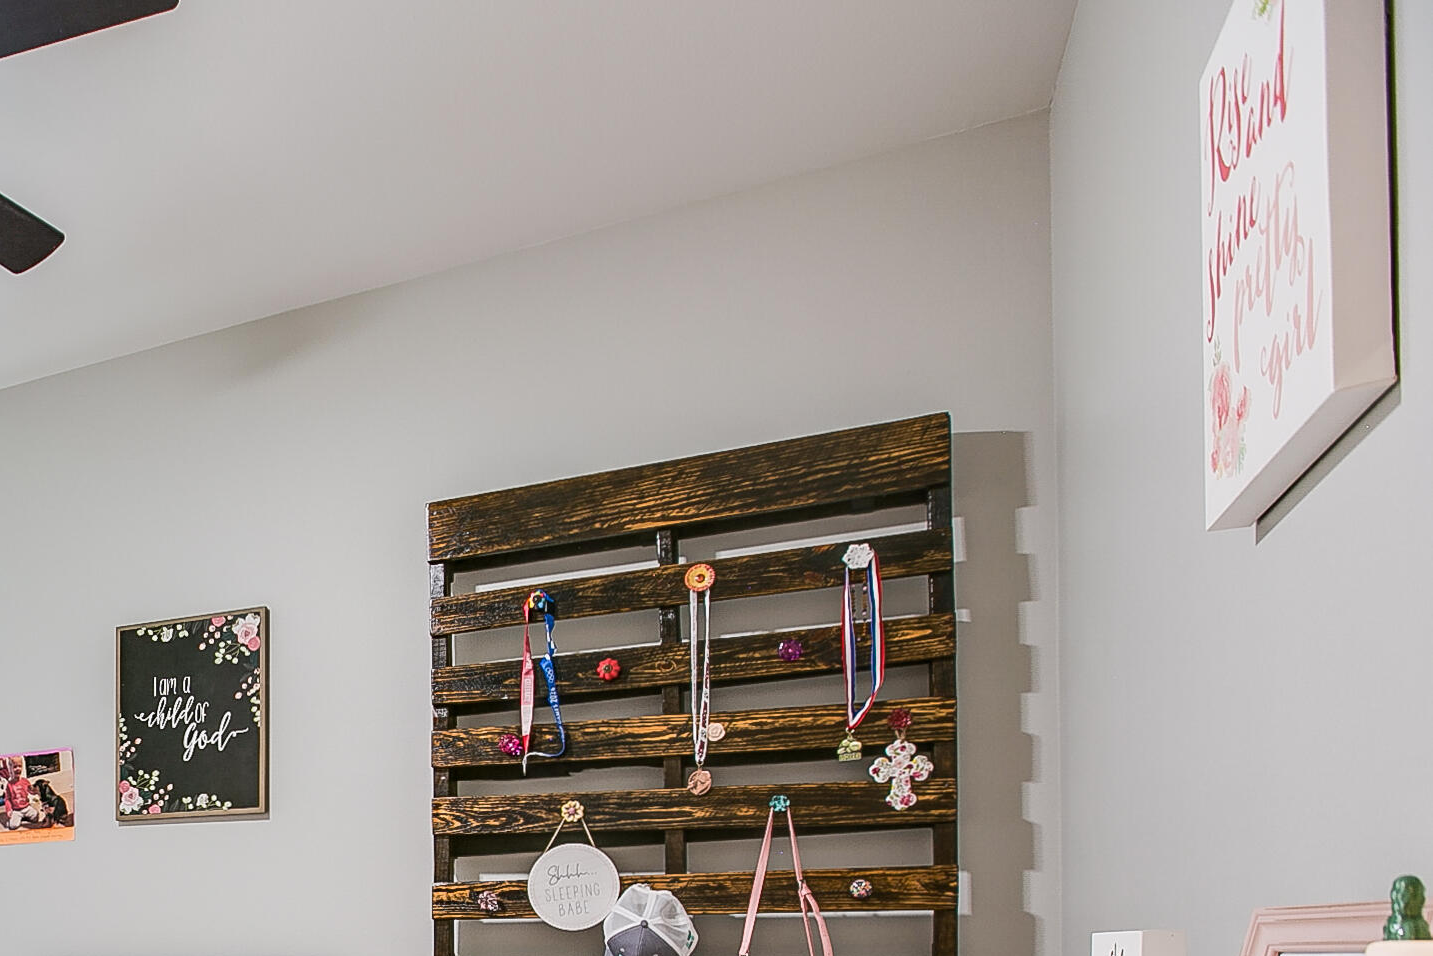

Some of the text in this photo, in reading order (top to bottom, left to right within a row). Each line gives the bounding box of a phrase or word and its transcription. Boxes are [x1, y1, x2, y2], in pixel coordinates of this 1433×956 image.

[1205, 0, 1294, 217] Rise and
[1206, 176, 1261, 343] shine
[1234, 160, 1306, 374] pretty
[1260, 237, 1323, 420] girl
[153, 676, 191, 697] I am a
[134, 695, 195, 730] child
[183, 711, 249, 762] God
[544, 882, 601, 902] SLEEPING
[558, 900, 589, 917] BABE
